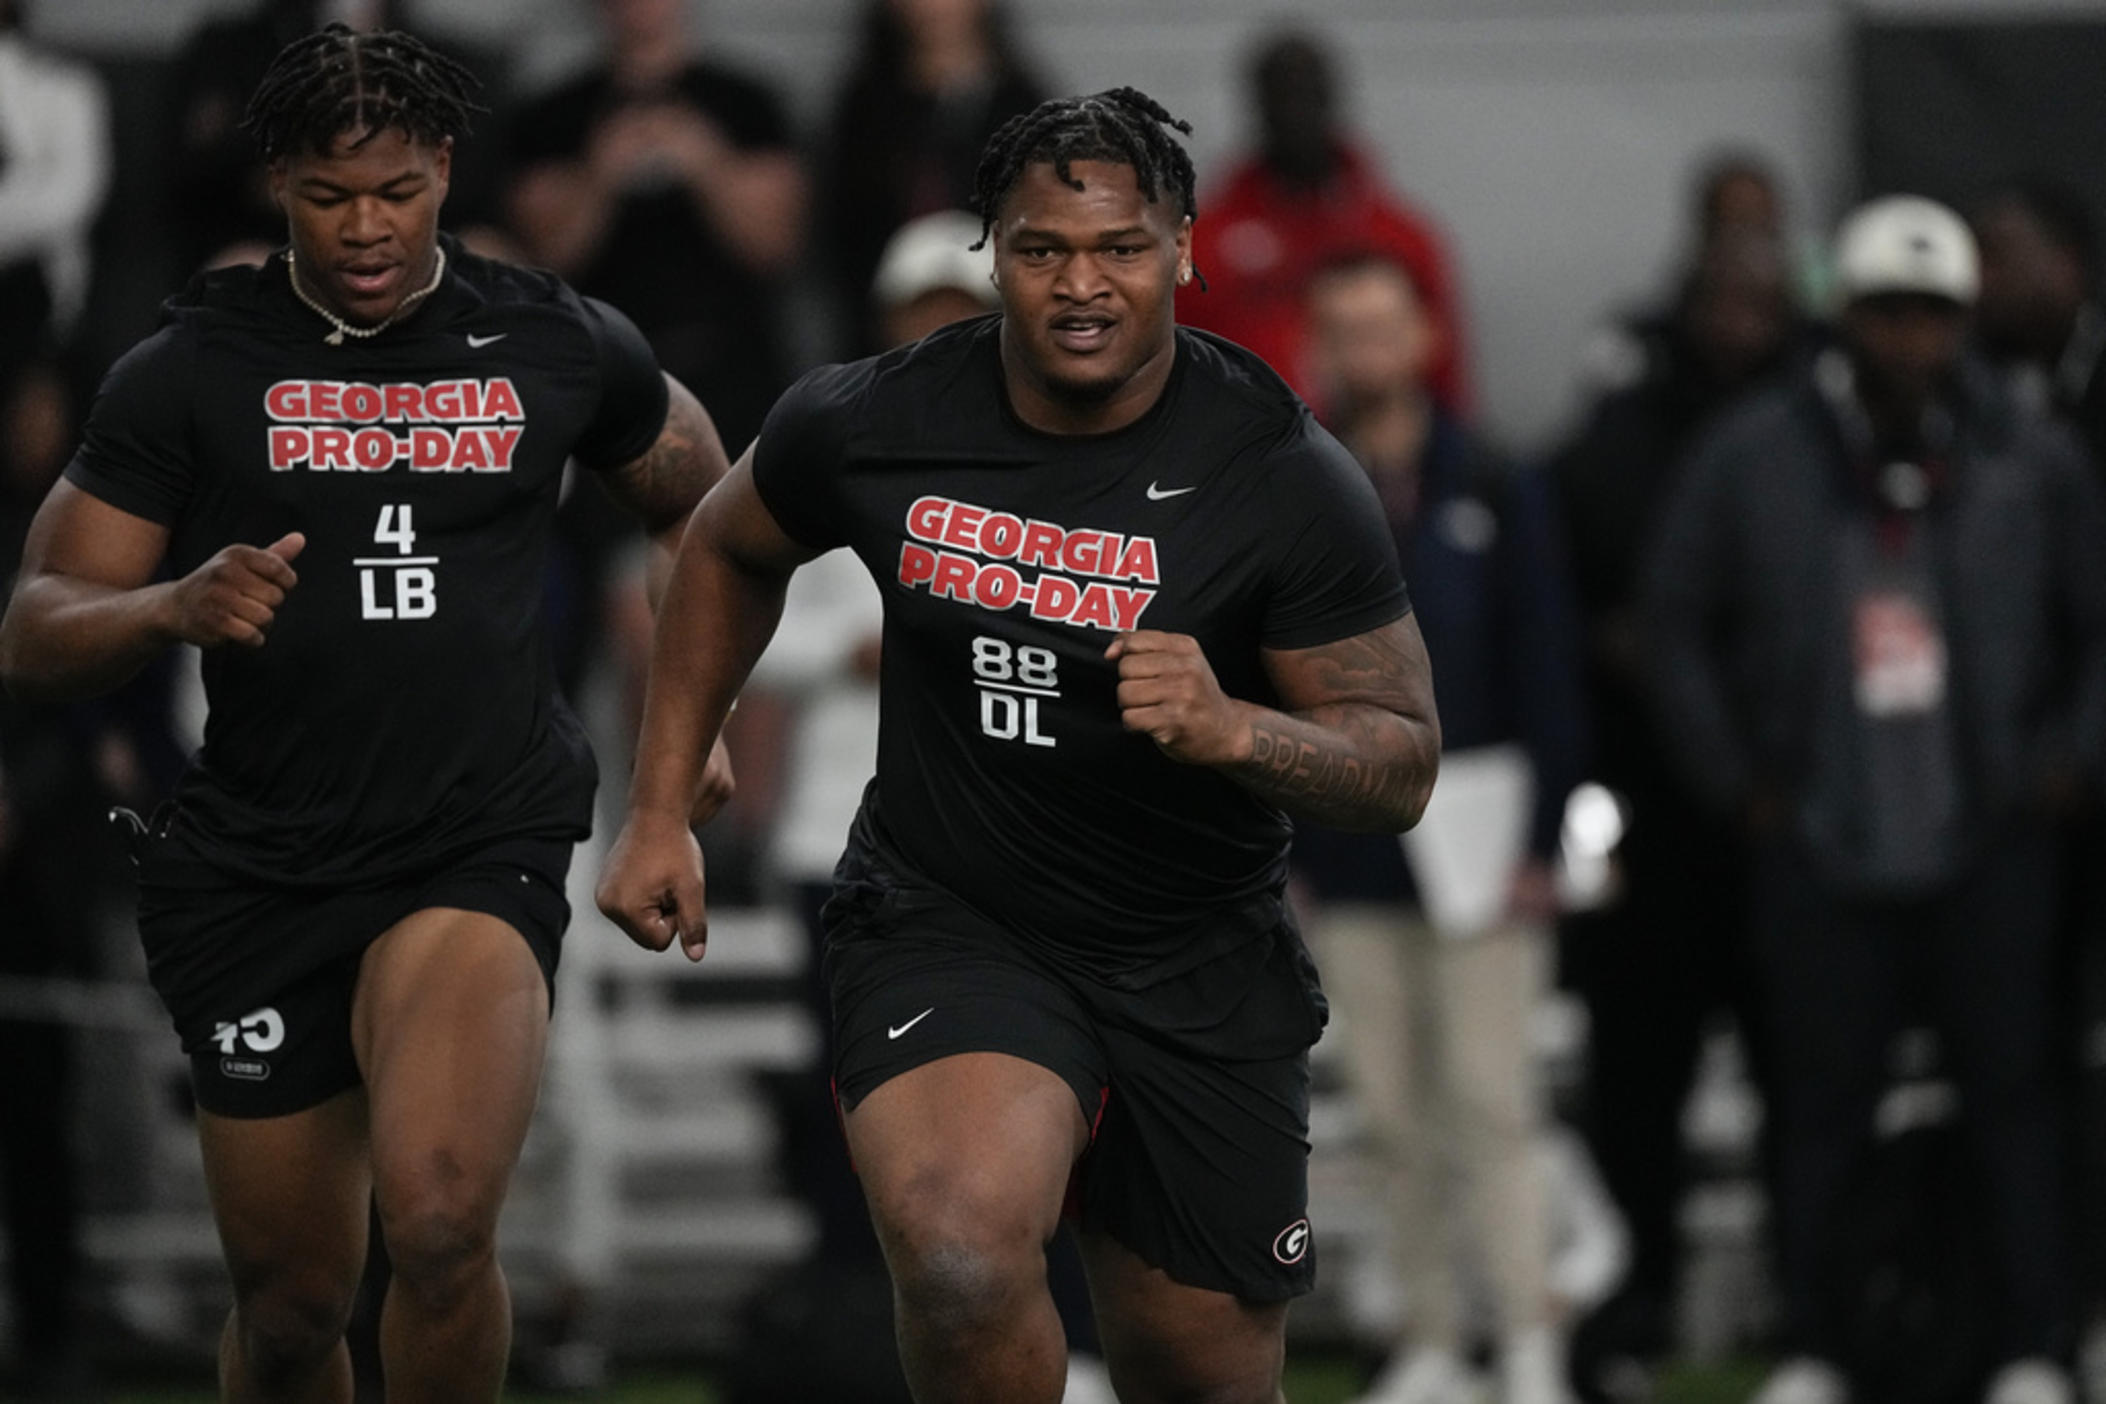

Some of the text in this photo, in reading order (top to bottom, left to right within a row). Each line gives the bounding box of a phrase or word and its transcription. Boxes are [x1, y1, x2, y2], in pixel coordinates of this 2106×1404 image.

[265, 378, 525, 423] GEORGIA
[267, 424, 525, 473] PRO-DAY
[374, 504, 416, 555] 4
[906, 495, 1160, 584] GEORGIA
[360, 567, 437, 620] LB
[898, 541, 1156, 632] PRO-DAY
[972, 636, 1058, 688] 88
[980, 690, 1056, 748] DL
